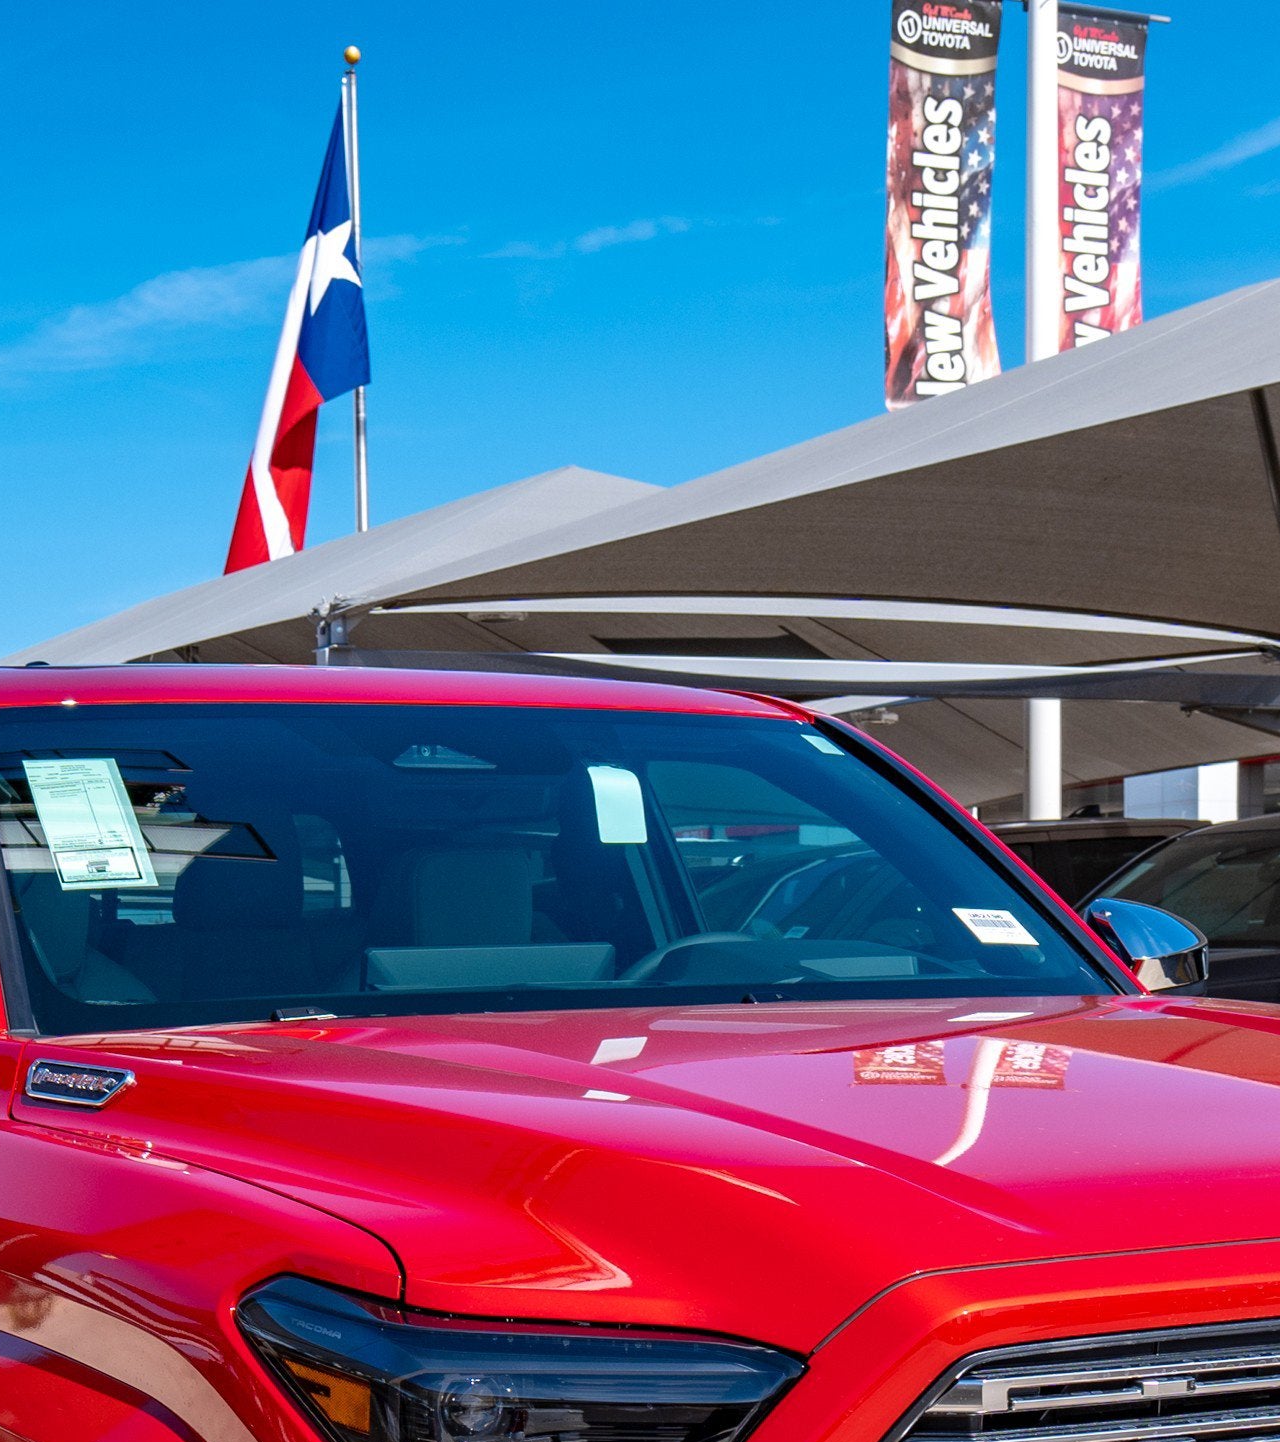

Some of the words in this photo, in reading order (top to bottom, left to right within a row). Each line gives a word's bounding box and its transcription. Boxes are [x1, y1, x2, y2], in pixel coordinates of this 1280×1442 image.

[922, 15, 993, 38] UNIVERSAL
[922, 31, 971, 50] TOYOTA
[1073, 37, 1138, 59] UNIVERSAL
[1073, 52, 1117, 71] TOYOTA
[912, 96, 963, 301] Vehicles
[1063, 113, 1112, 313] Vehicles
[291, 1317, 342, 1339] TACOMA
